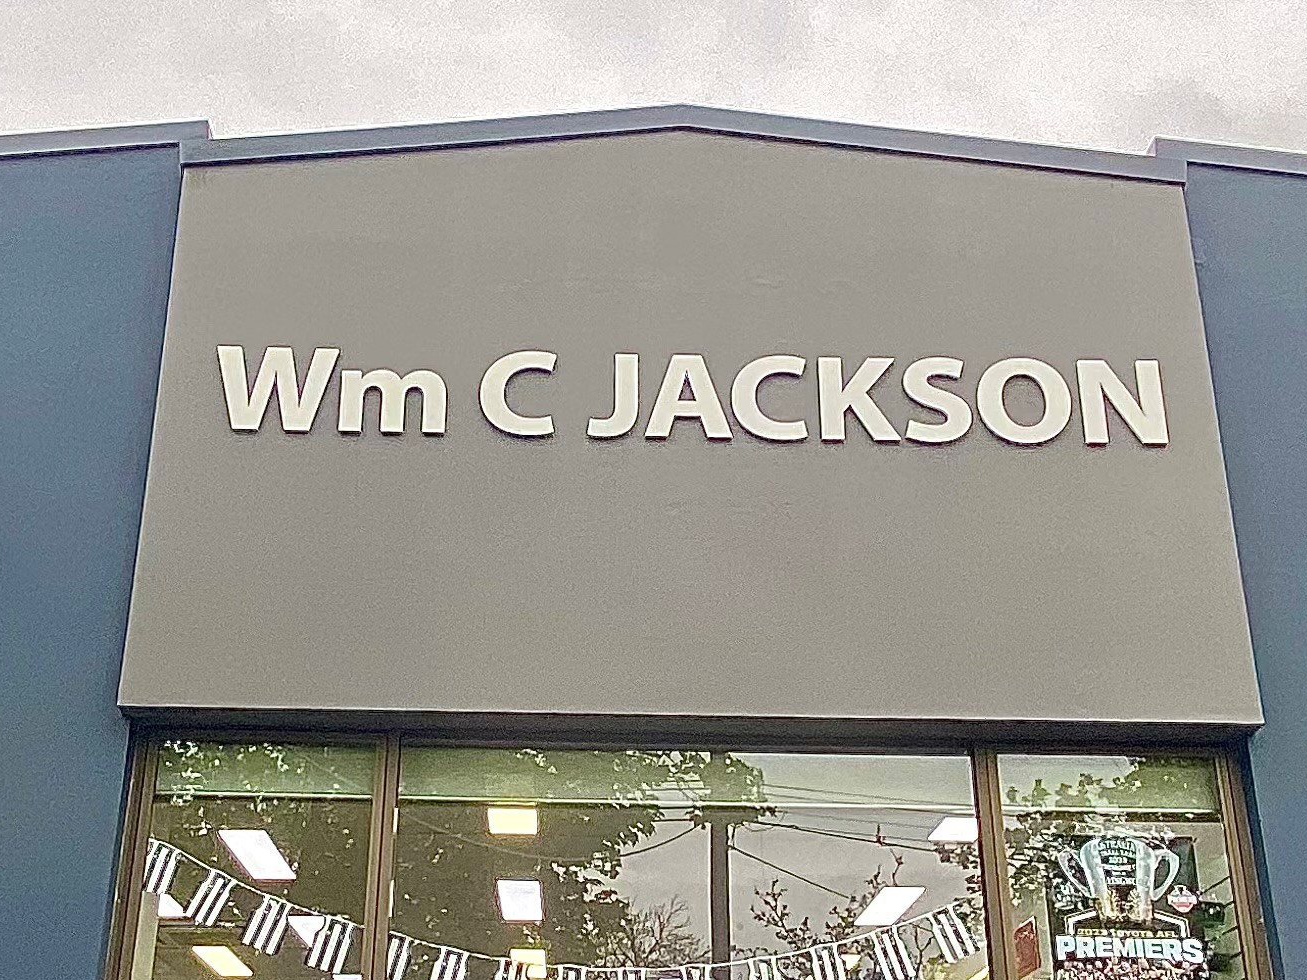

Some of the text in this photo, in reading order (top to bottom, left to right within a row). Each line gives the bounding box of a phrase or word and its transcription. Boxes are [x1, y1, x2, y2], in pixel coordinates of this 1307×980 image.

[216, 344, 1170, 447] Wm C JACKSON
[1110, 928, 1154, 938] TOYOTA
[1156, 930, 1179, 938] AFL
[1055, 935, 1204, 964] PREMIERS
